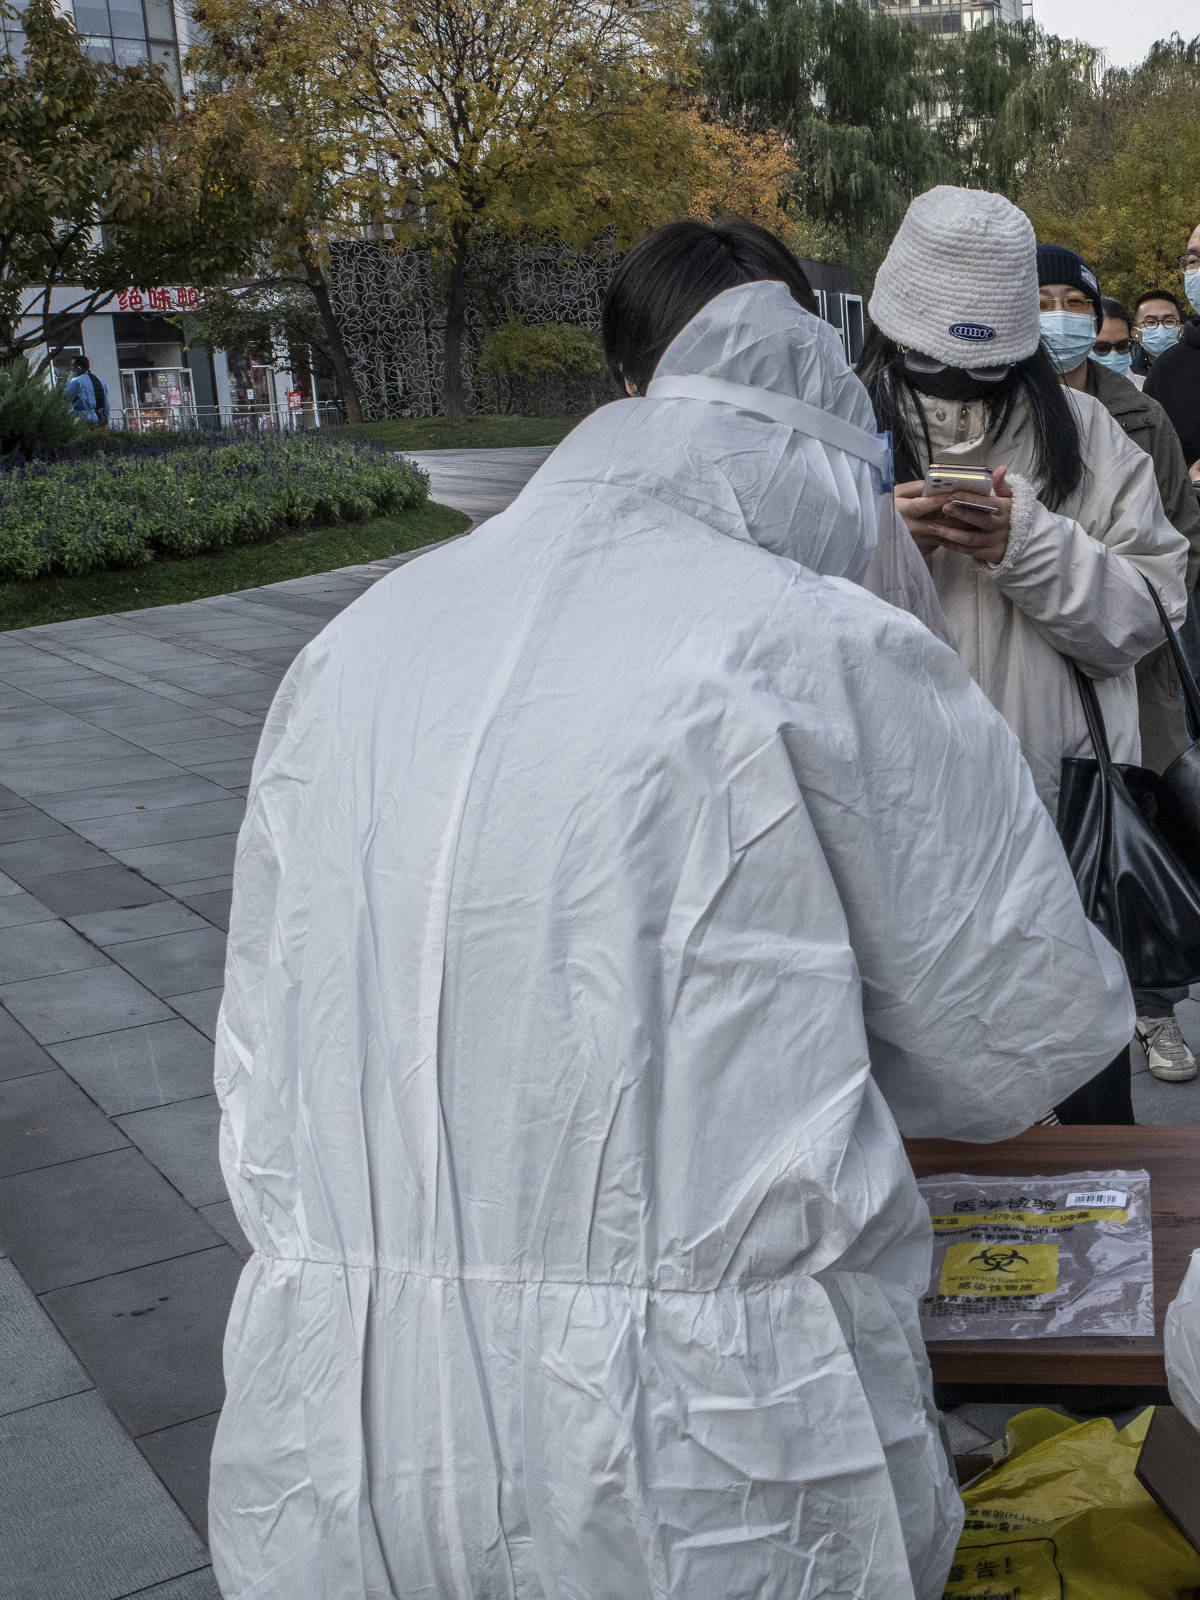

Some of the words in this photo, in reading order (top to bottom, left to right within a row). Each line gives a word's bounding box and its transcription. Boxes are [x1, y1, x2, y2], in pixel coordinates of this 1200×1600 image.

[118, 286, 212, 312] 绝味鸭
[958, 1282, 1033, 1291] 感染性物质
